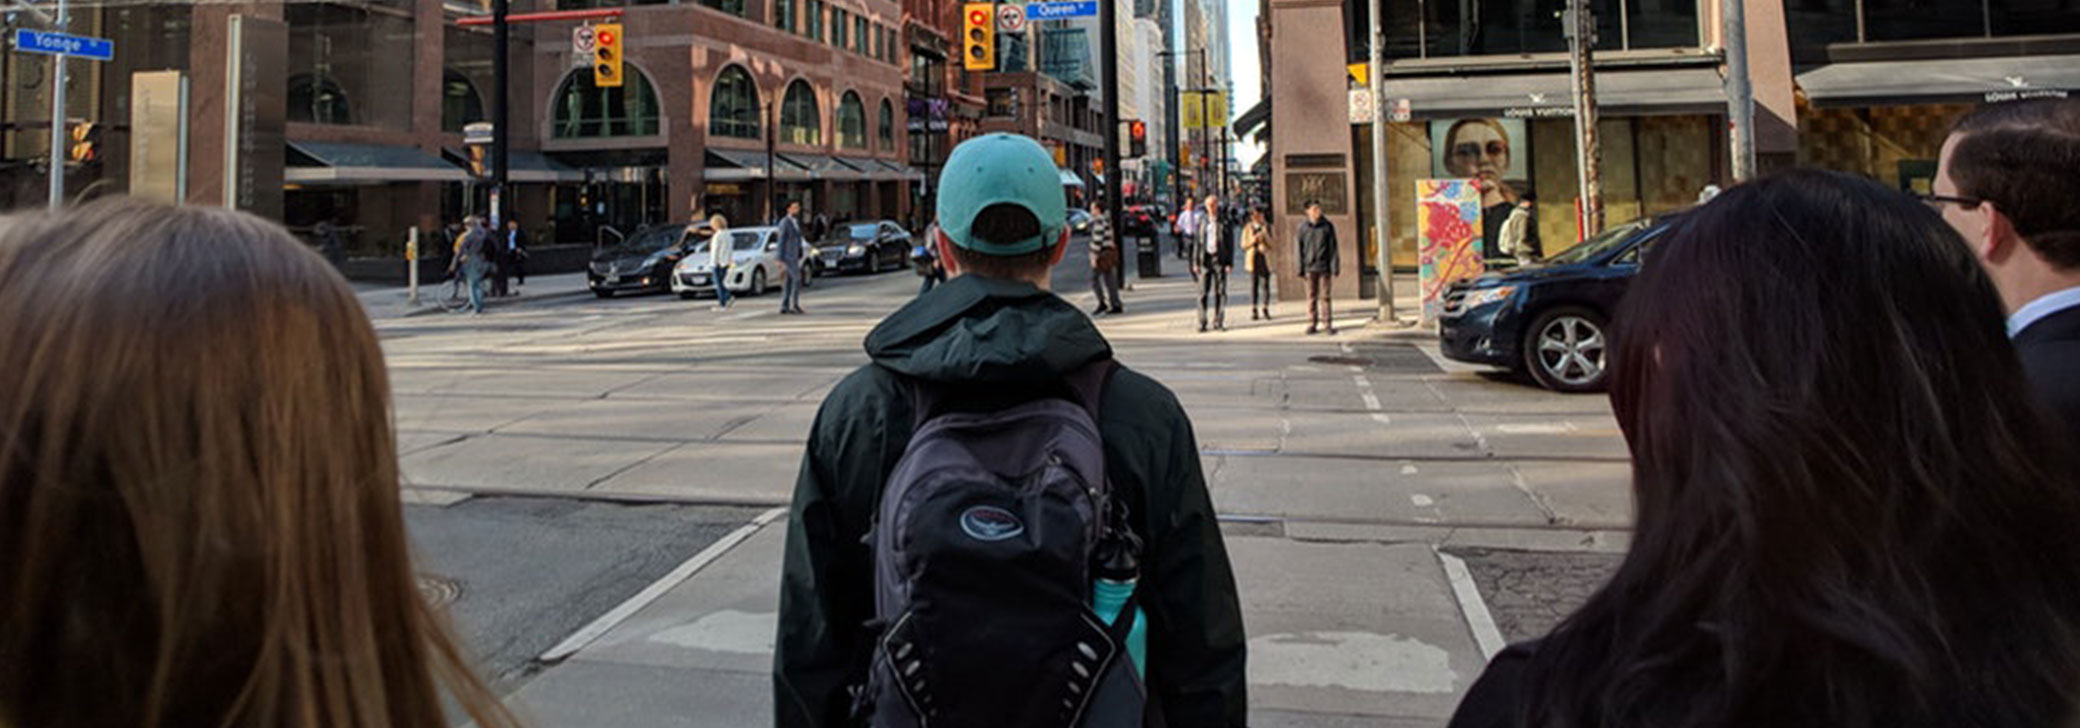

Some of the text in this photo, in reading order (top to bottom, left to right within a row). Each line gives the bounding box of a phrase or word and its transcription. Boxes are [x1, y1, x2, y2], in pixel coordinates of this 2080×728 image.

[1038, 3, 1077, 16] Queen
[34, 33, 81, 53] Yonge
[1504, 108, 1532, 117] LOUIS
